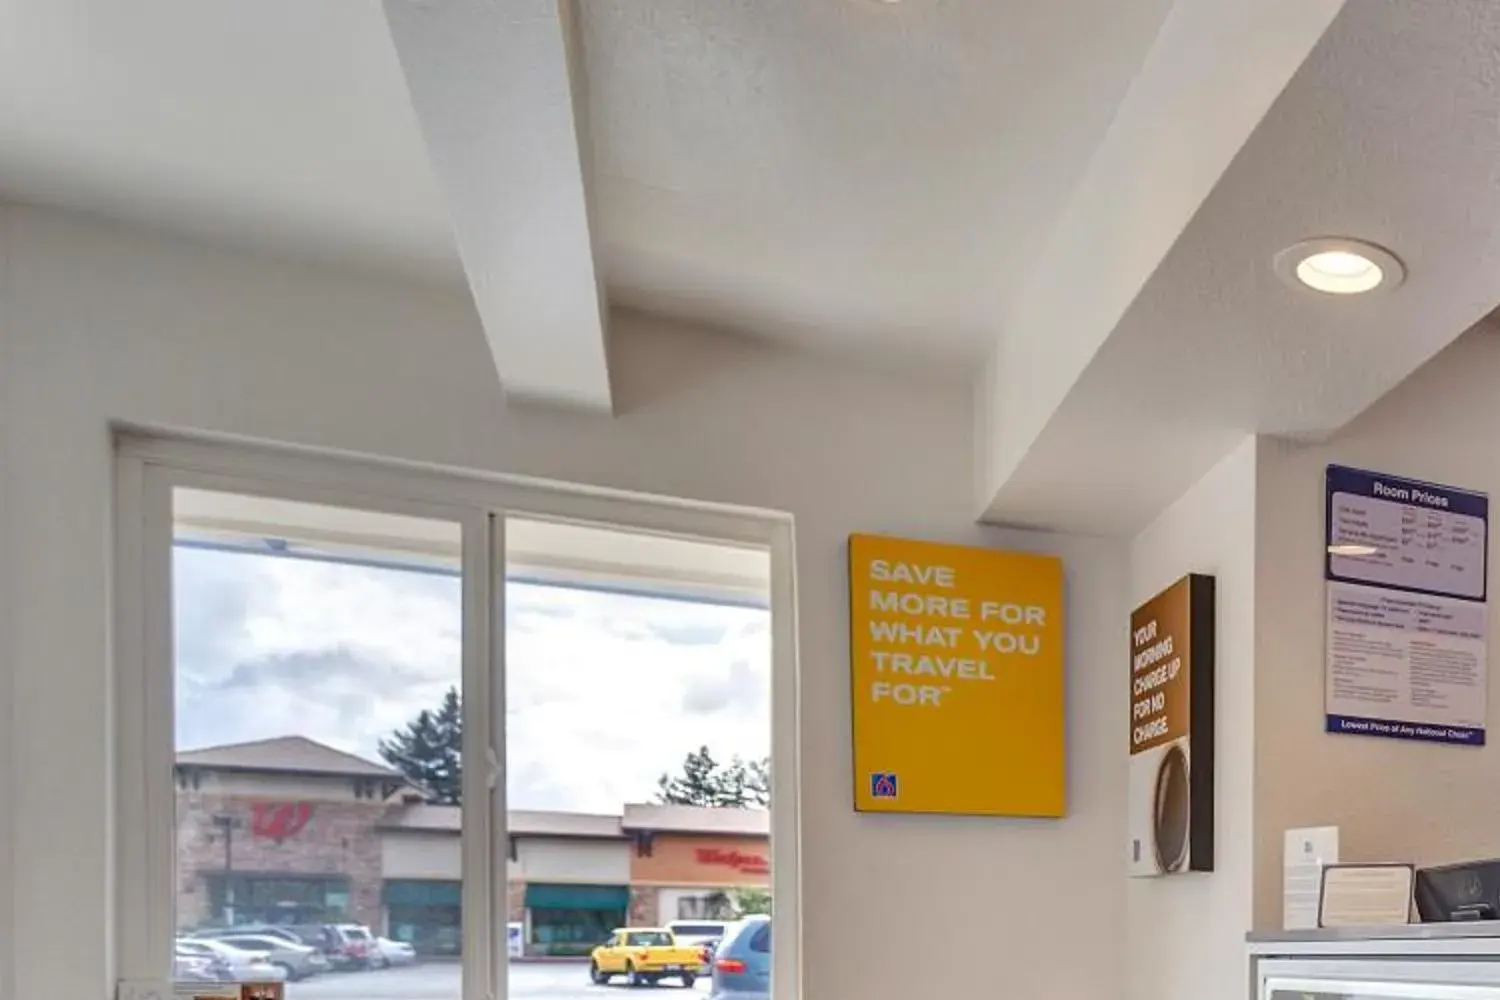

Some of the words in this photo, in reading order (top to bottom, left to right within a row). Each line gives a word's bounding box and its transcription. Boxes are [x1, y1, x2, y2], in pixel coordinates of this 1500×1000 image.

[1373, 481, 1409, 500] Room
[1411, 489, 1449, 507] Prices
[869, 559, 956, 588] SAVE
[869, 590, 971, 619] MORE
[980, 601, 1047, 627] FOR
[869, 620, 963, 648] WHAT
[973, 629, 1041, 656] YOU
[1133, 619, 1157, 648] YOUR
[870, 651, 996, 681] TRAVEL
[1133, 635, 1173, 673] MORNING
[1133, 664, 1168, 696] CHARGE
[1167, 657, 1181, 680] UP
[1133, 697, 1151, 721] FOR
[1151, 691, 1165, 713] NO
[1133, 715, 1169, 745] CHARGE
[1341, 719, 1369, 731] Lowest
[1391, 724, 1400, 733] of
[1400, 726, 1415, 737] Any
[1416, 727, 1447, 738] National
